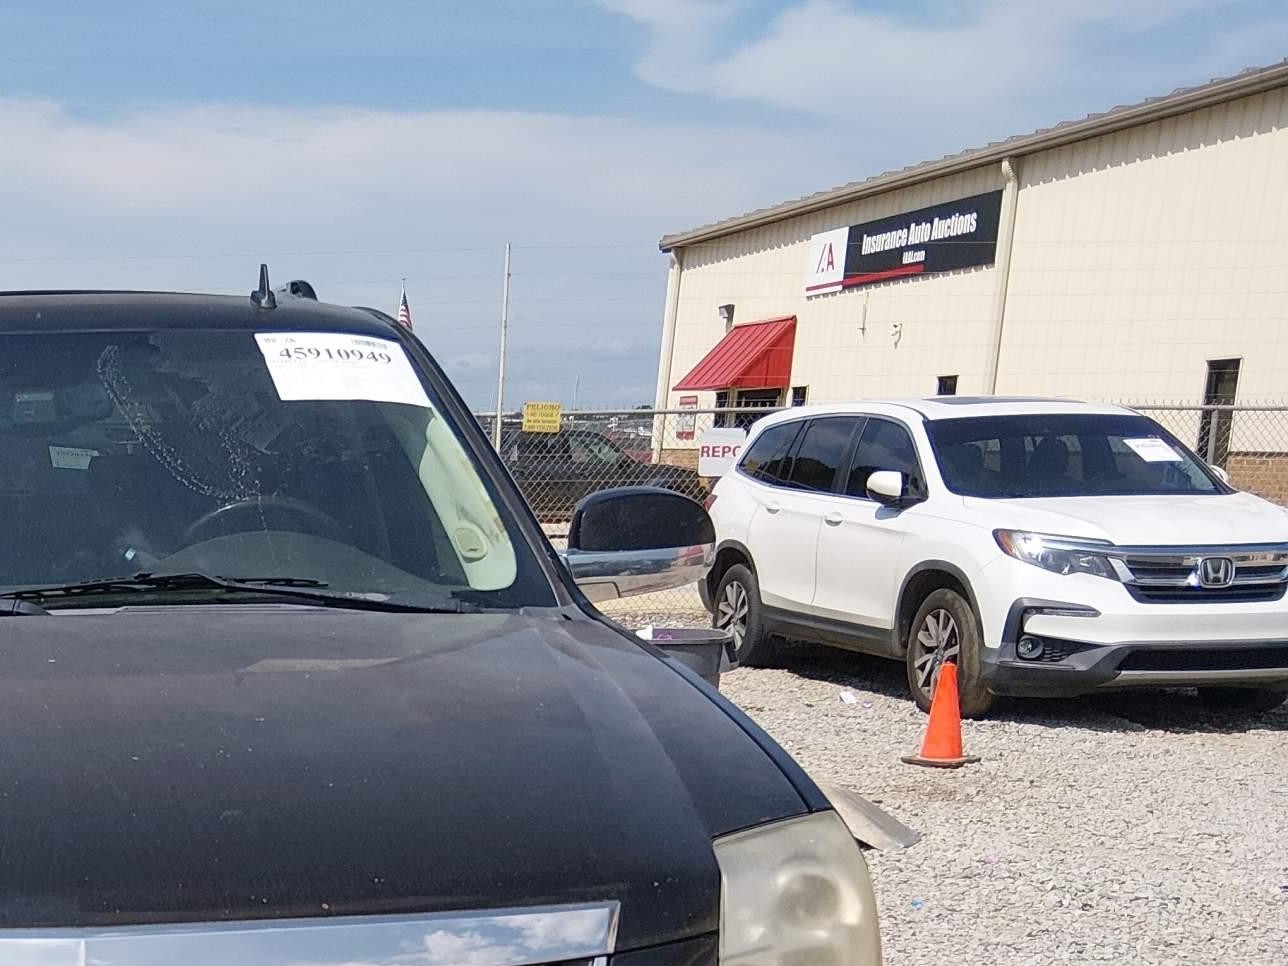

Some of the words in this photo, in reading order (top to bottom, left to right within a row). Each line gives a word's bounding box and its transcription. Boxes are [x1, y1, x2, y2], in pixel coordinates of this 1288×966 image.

[862, 228, 908, 256] Insurance
[908, 222, 931, 245] Auto
[931, 212, 978, 240] Auctions
[279, 347, 392, 364] 45910949
